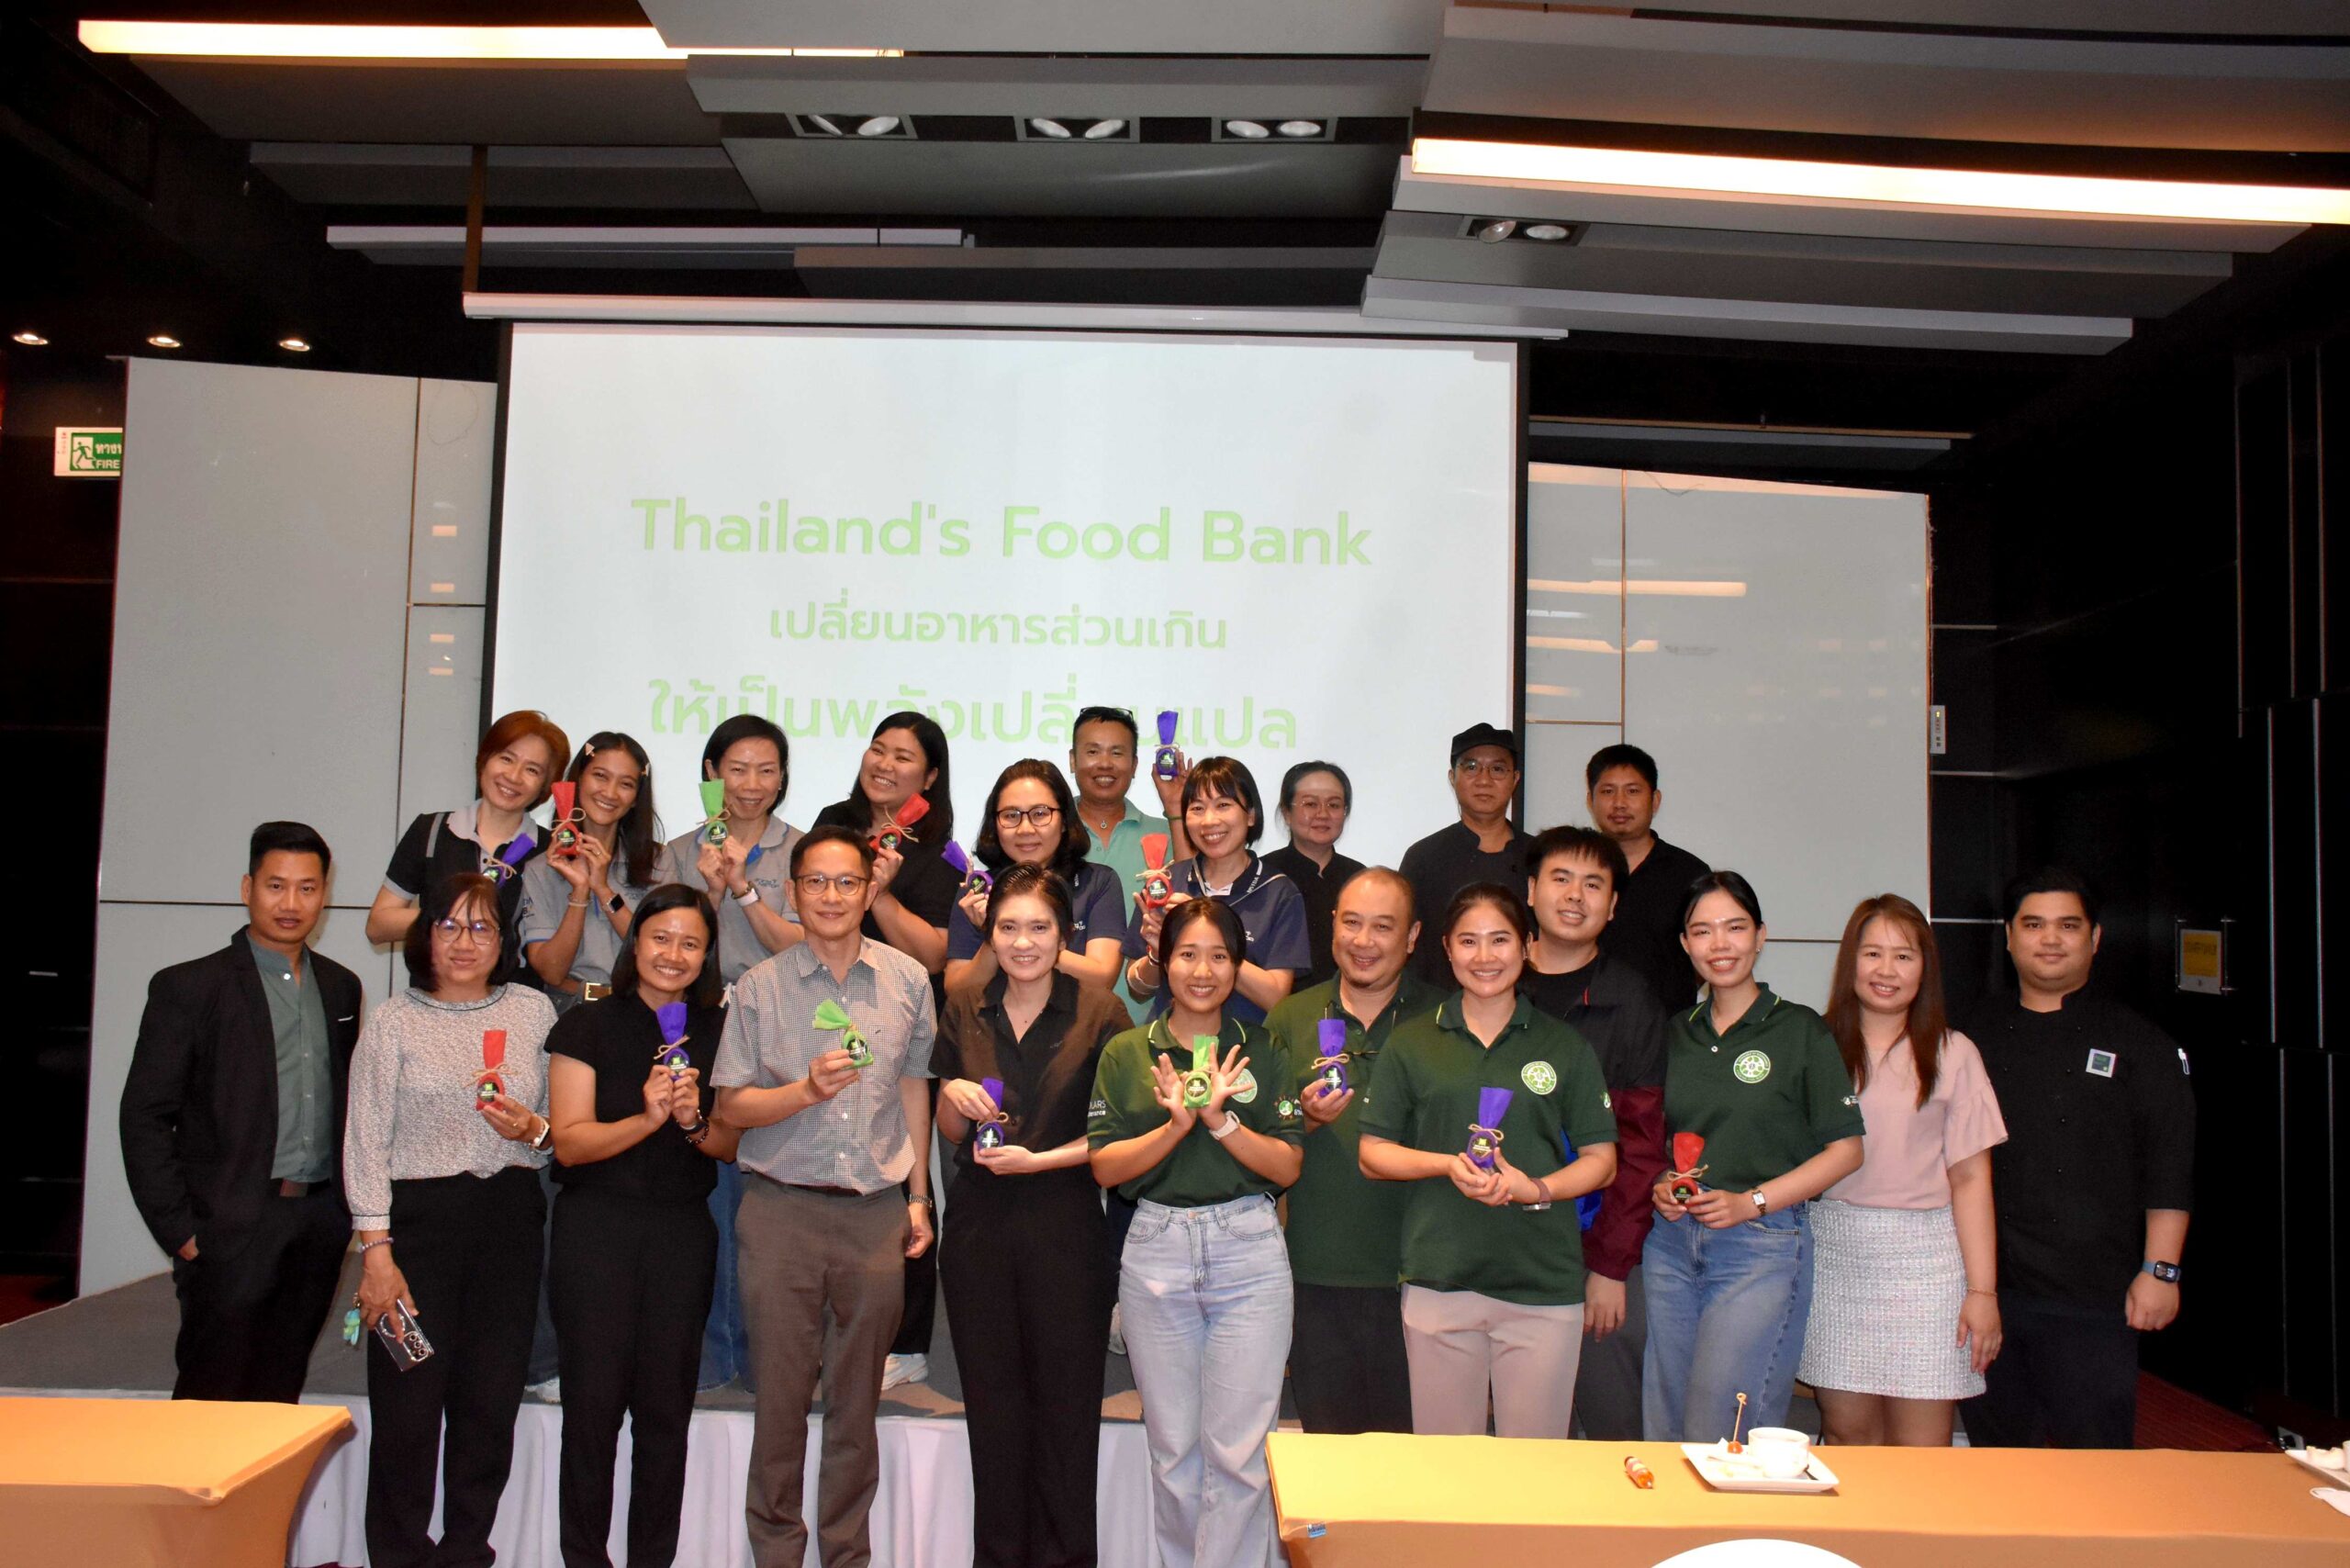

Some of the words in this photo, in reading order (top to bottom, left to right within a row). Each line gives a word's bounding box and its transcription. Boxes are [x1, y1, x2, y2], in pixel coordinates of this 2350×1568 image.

[95, 459, 120, 469] FIRE
[631, 497, 970, 557] Thailand's
[1002, 505, 1171, 561] Food
[1203, 510, 1372, 566] Bank
[770, 588, 1227, 649] เปลี่ยนอาหารส่วนเกิน
